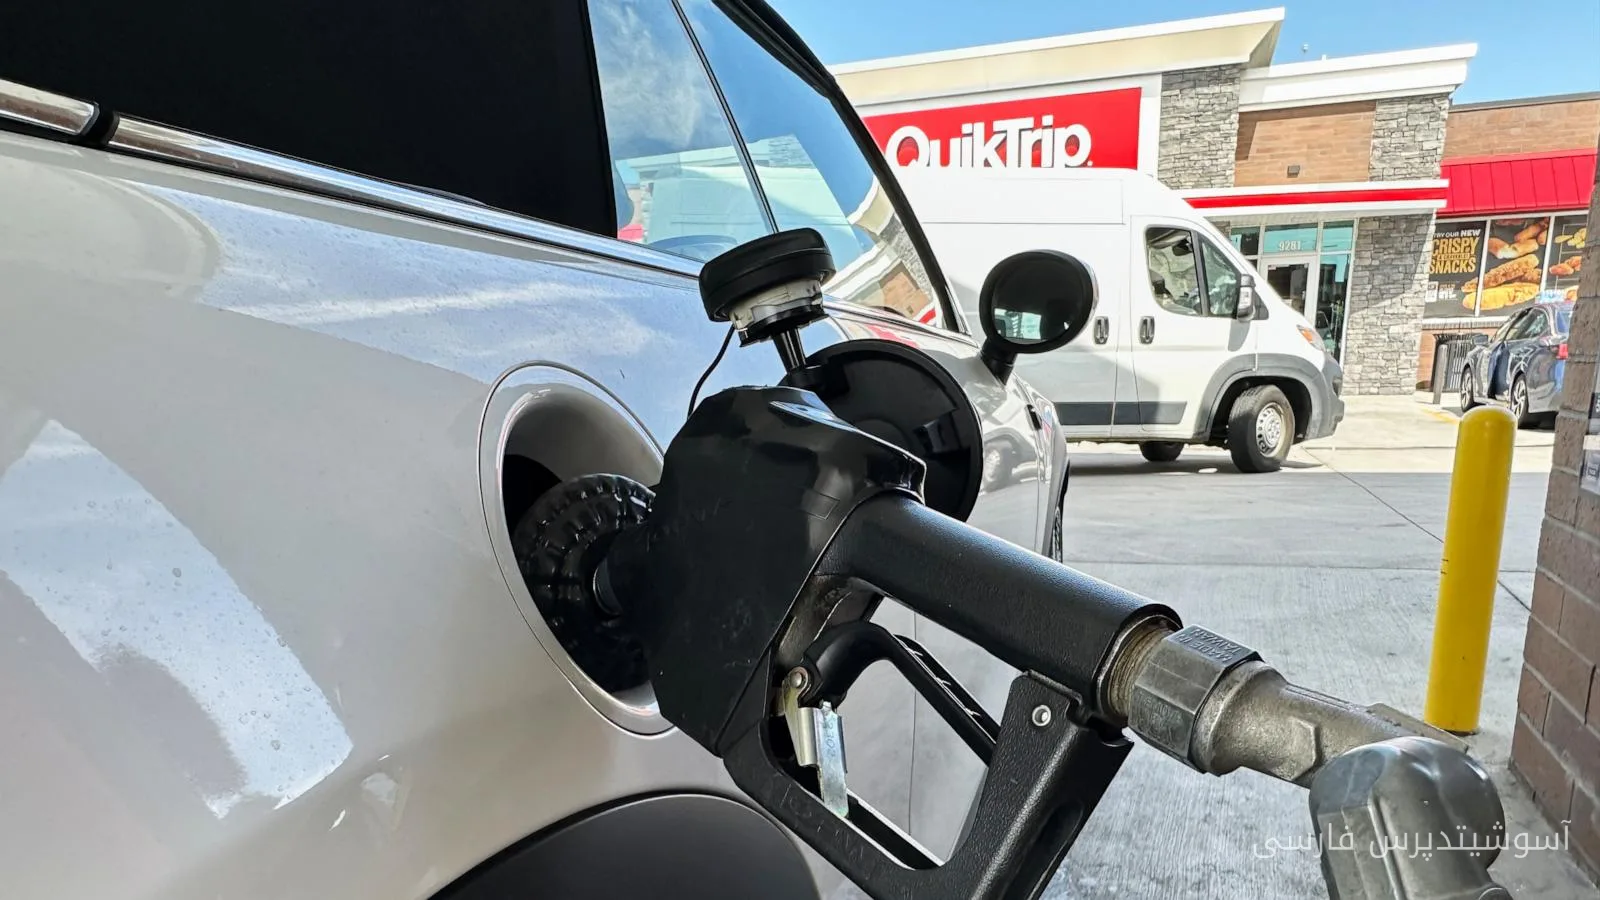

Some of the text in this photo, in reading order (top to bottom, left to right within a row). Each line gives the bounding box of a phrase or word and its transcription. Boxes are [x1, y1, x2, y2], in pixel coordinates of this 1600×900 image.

[885, 114, 1092, 168] QuikTrip
[1460, 229, 1481, 237] NEW
[1279, 240, 1301, 251] 9281
[1432, 237, 1480, 256] CRISPY
[1429, 257, 1476, 274] SNACKS
[1190, 628, 1241, 654] TAIWAN
[1190, 642, 1233, 662] MADE
